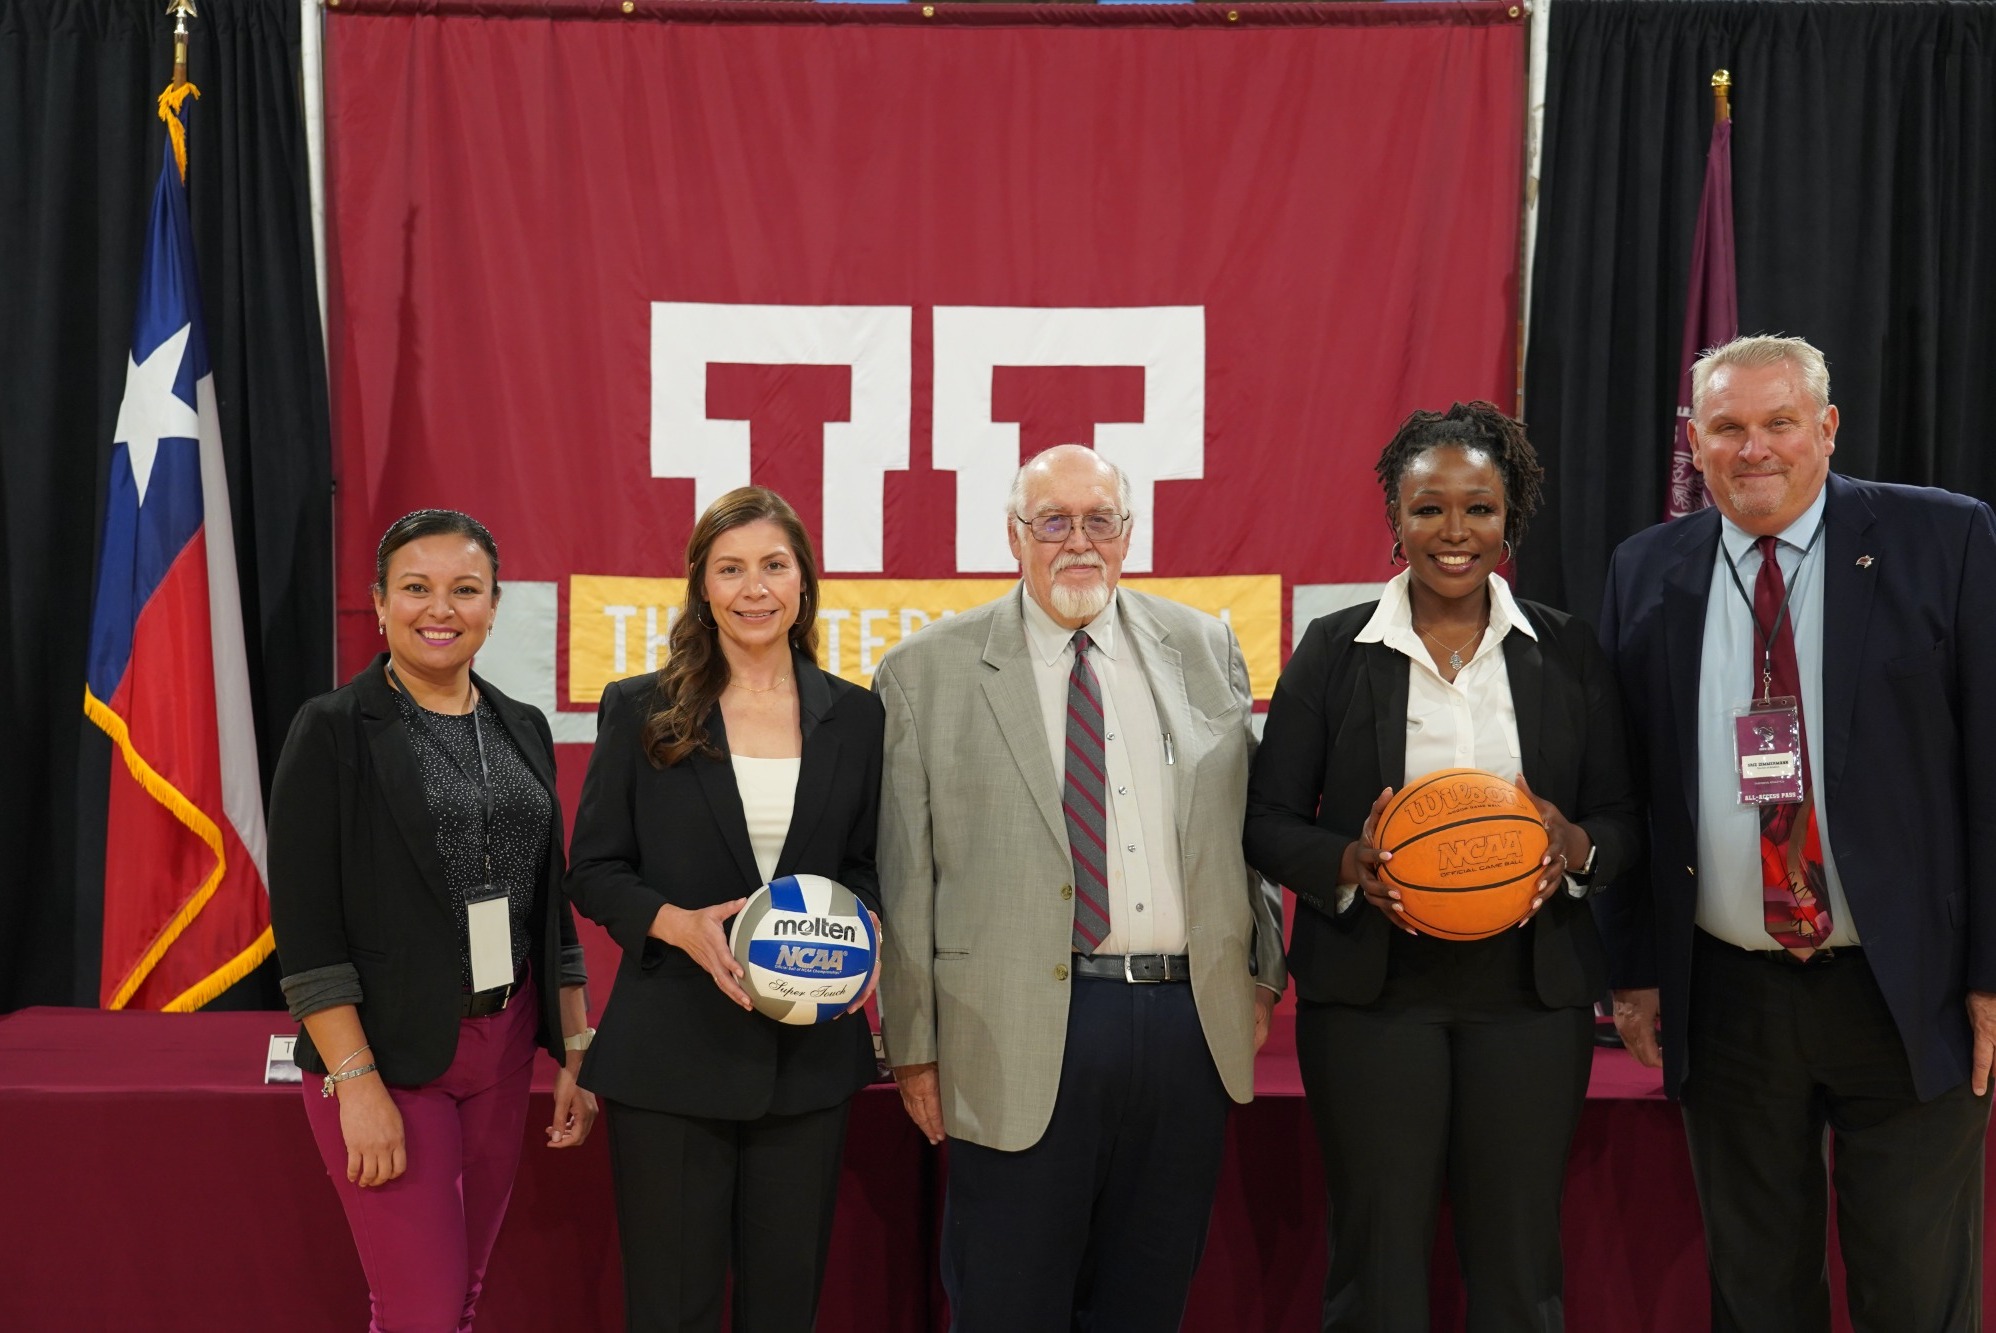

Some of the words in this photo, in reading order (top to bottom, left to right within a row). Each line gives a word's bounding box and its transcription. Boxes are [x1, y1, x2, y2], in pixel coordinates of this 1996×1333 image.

[604, 605, 681, 674] TH
[1404, 782, 1527, 824] Wilson
[1438, 830, 1523, 871] NCAA
[1440, 868, 1477, 877] OFFICIAL
[1479, 862, 1503, 871] GAME
[774, 917, 856, 942] molten
[776, 944, 843, 971] NCAA
[768, 979, 806, 997] Super
[810, 984, 847, 998] Touch
